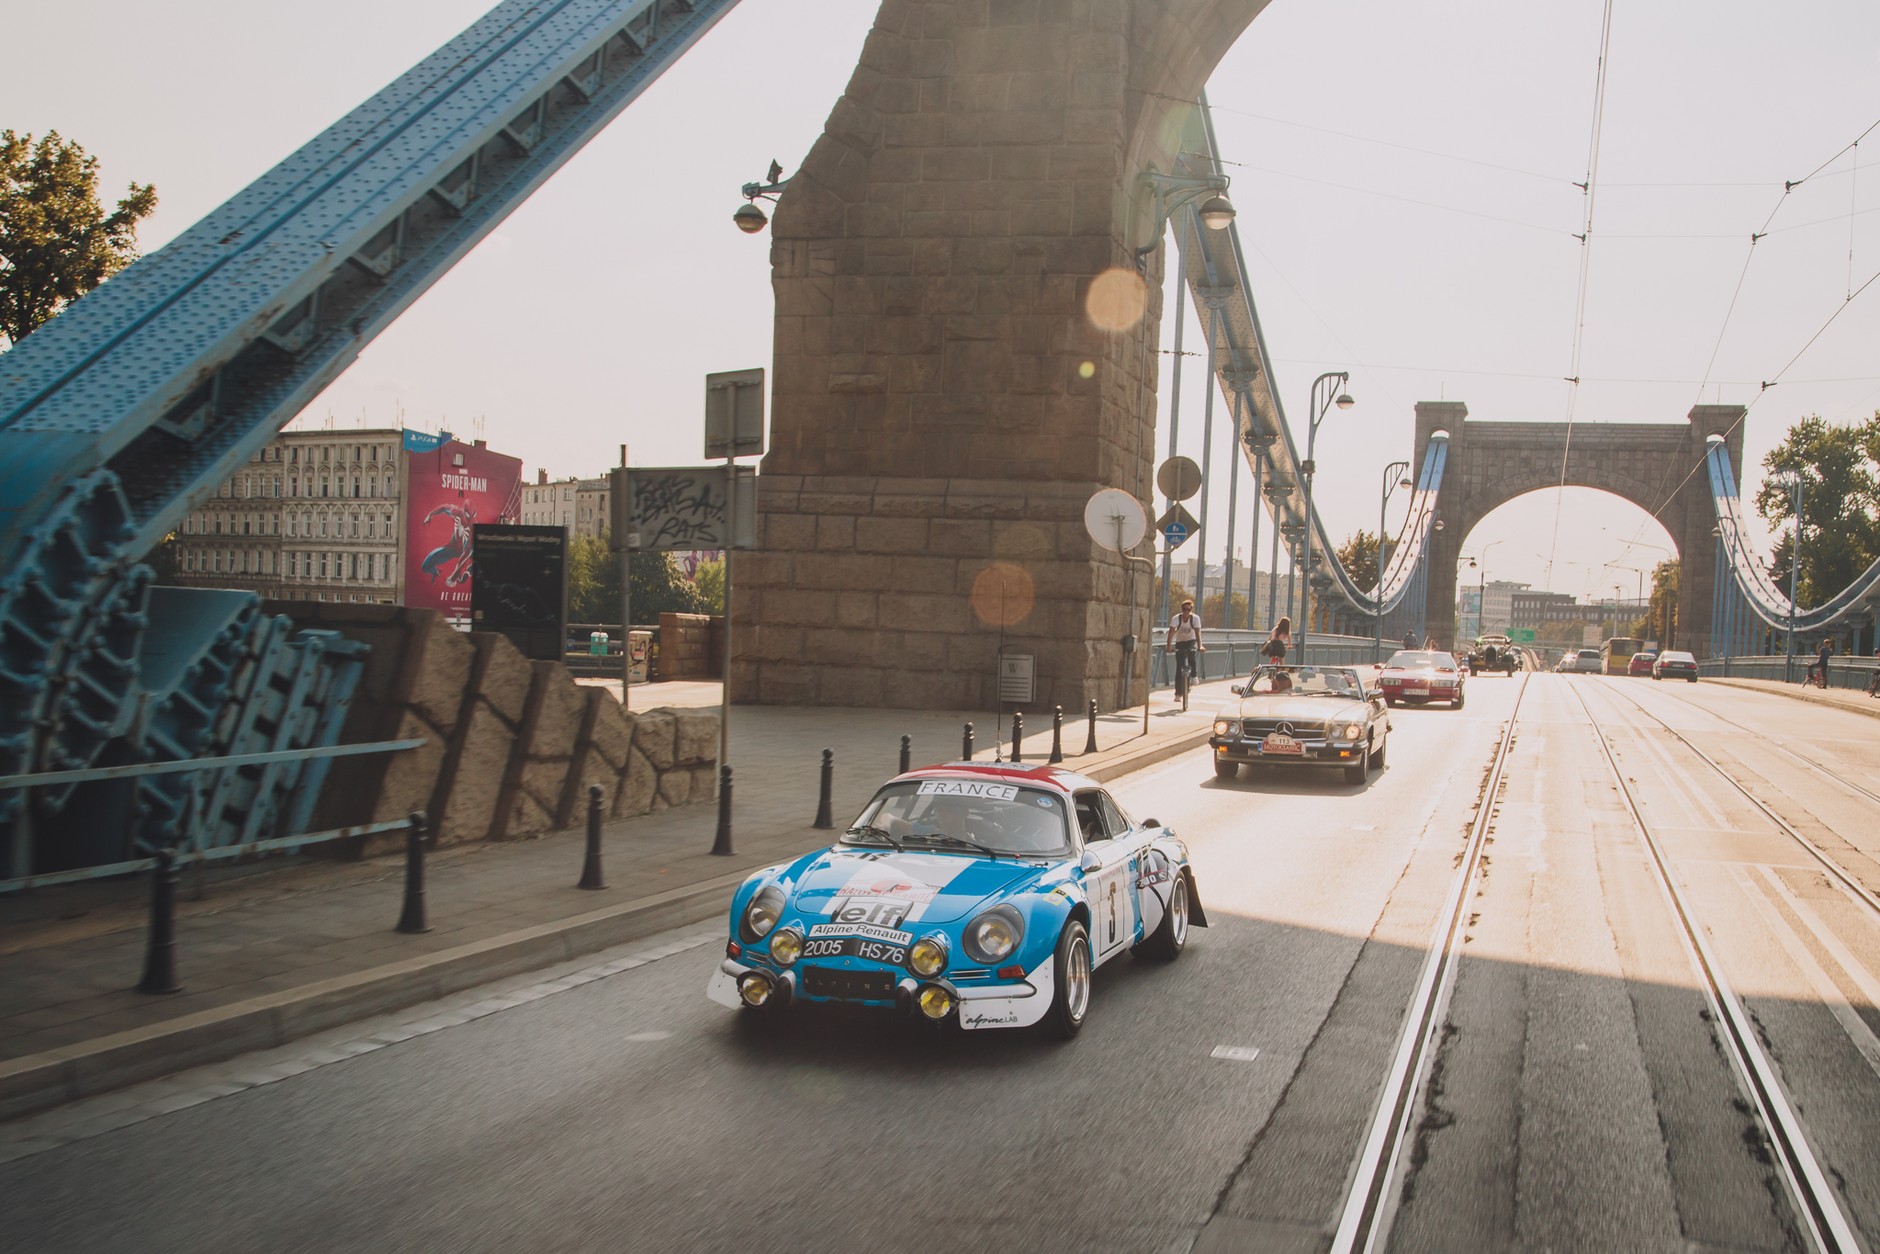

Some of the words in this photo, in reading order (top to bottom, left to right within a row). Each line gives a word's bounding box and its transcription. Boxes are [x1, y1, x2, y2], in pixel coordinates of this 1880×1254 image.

[650, 516, 718, 547] RATS
[920, 782, 1015, 799] FRANCE
[840, 903, 903, 926] elf
[1108, 881, 1117, 944] 3
[814, 924, 853, 935] Alpine
[856, 924, 908, 942] Renault
[803, 940, 844, 956] 2005
